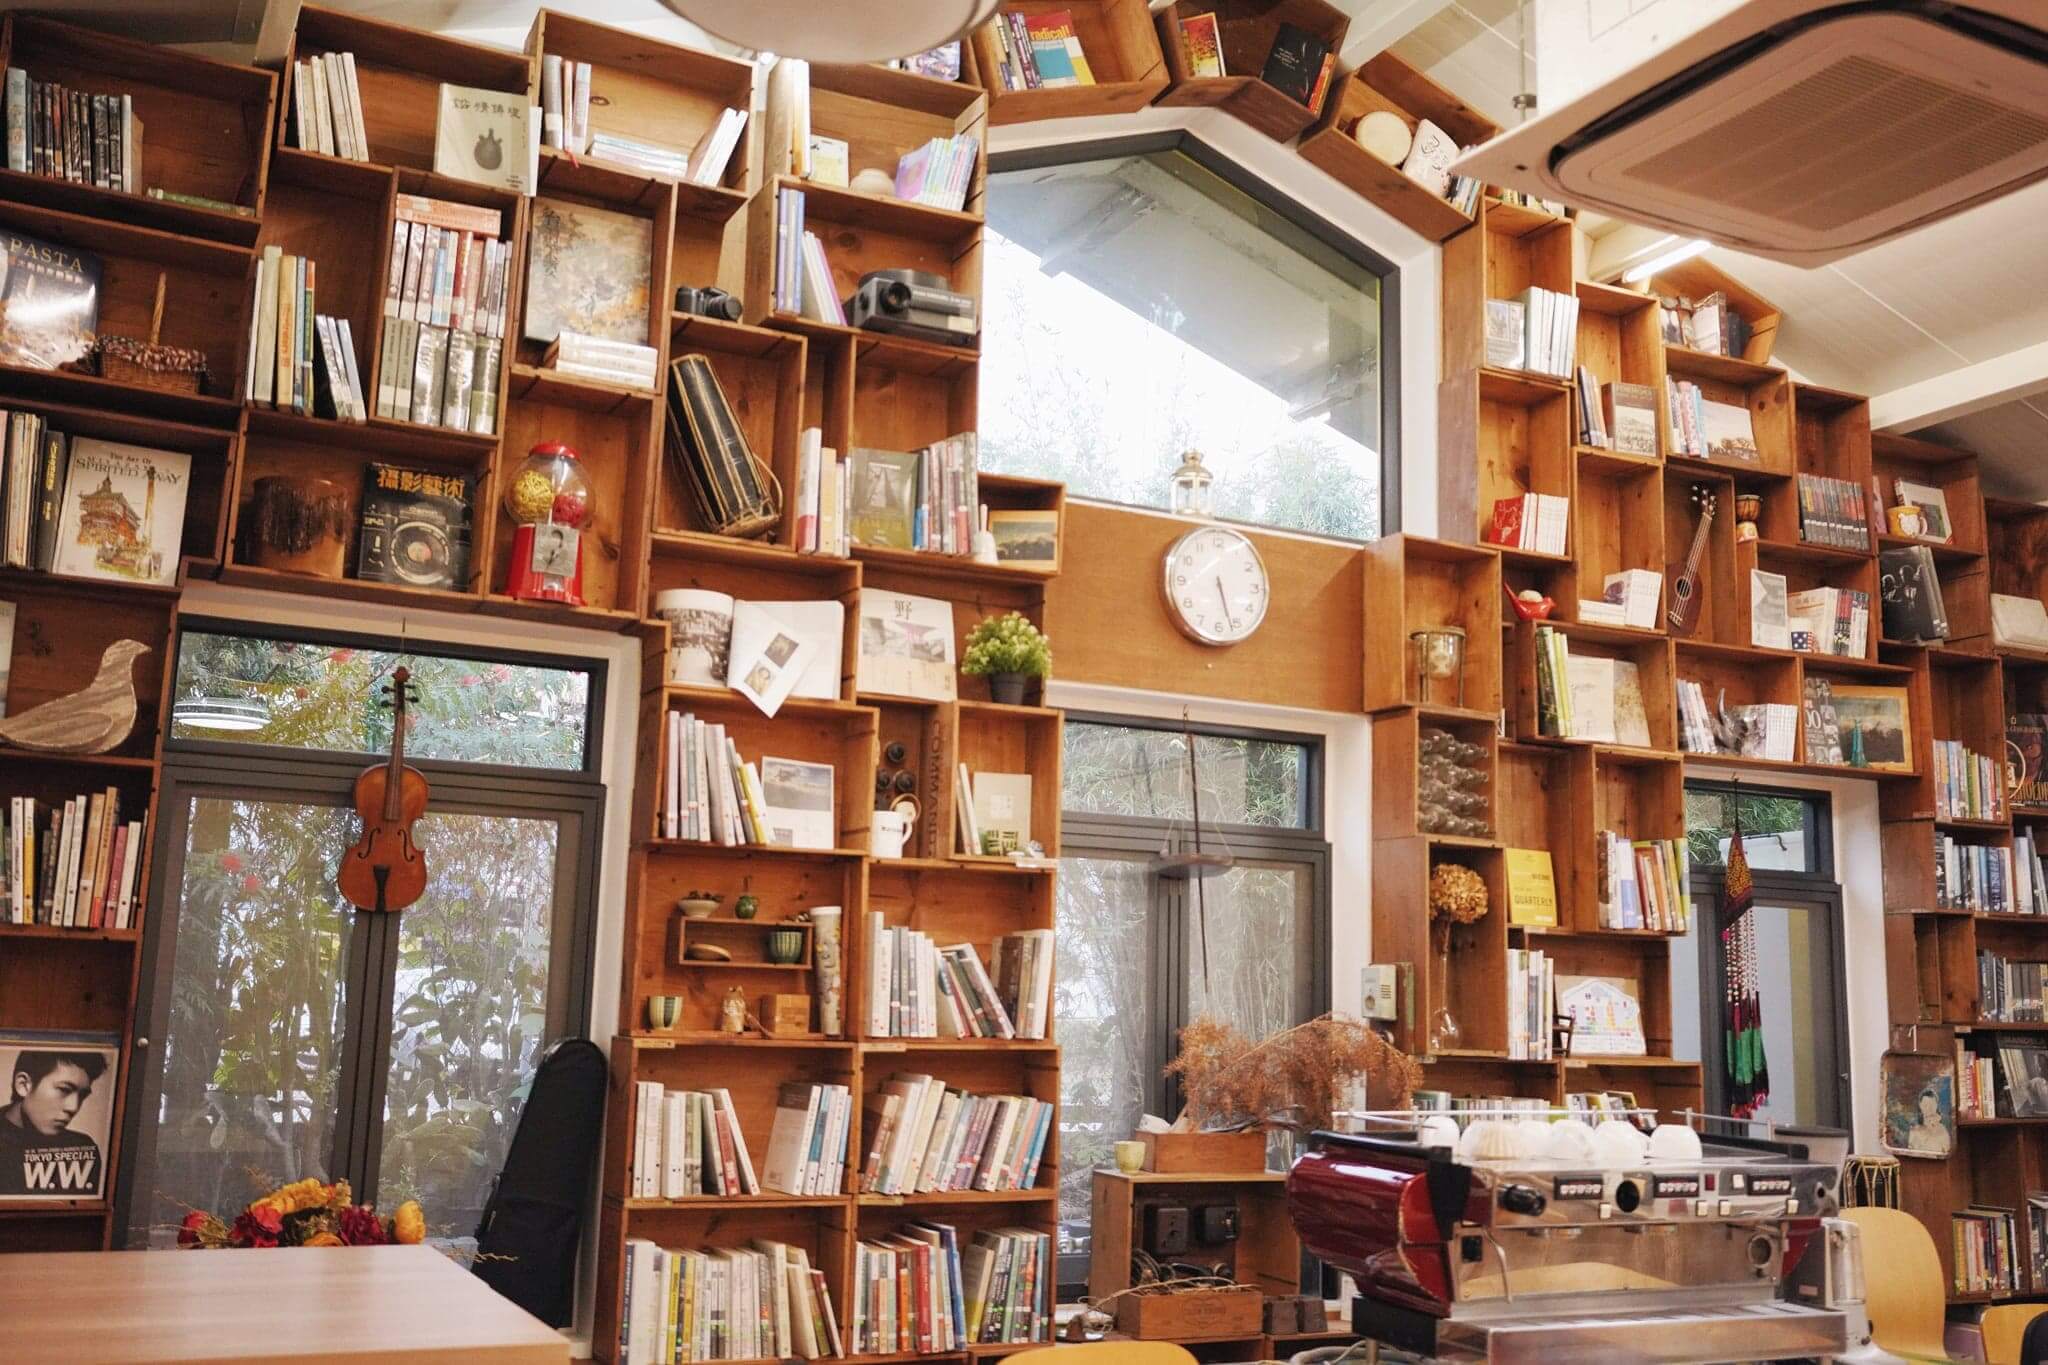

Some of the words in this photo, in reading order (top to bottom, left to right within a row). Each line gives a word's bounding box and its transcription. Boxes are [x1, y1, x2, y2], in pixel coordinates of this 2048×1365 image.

[10, 238, 82, 273] PASTA
[1245, 562, 1254, 573] 2
[1177, 575, 1186, 586] 9
[1250, 583, 1260, 594] 3
[1197, 614, 1205, 626] 7
[1215, 621, 1224, 633] 6
[24, 1152, 53, 1163] TOKYO
[54, 1151, 97, 1161] SPECIAL
[23, 1160, 94, 1190] W.W.
